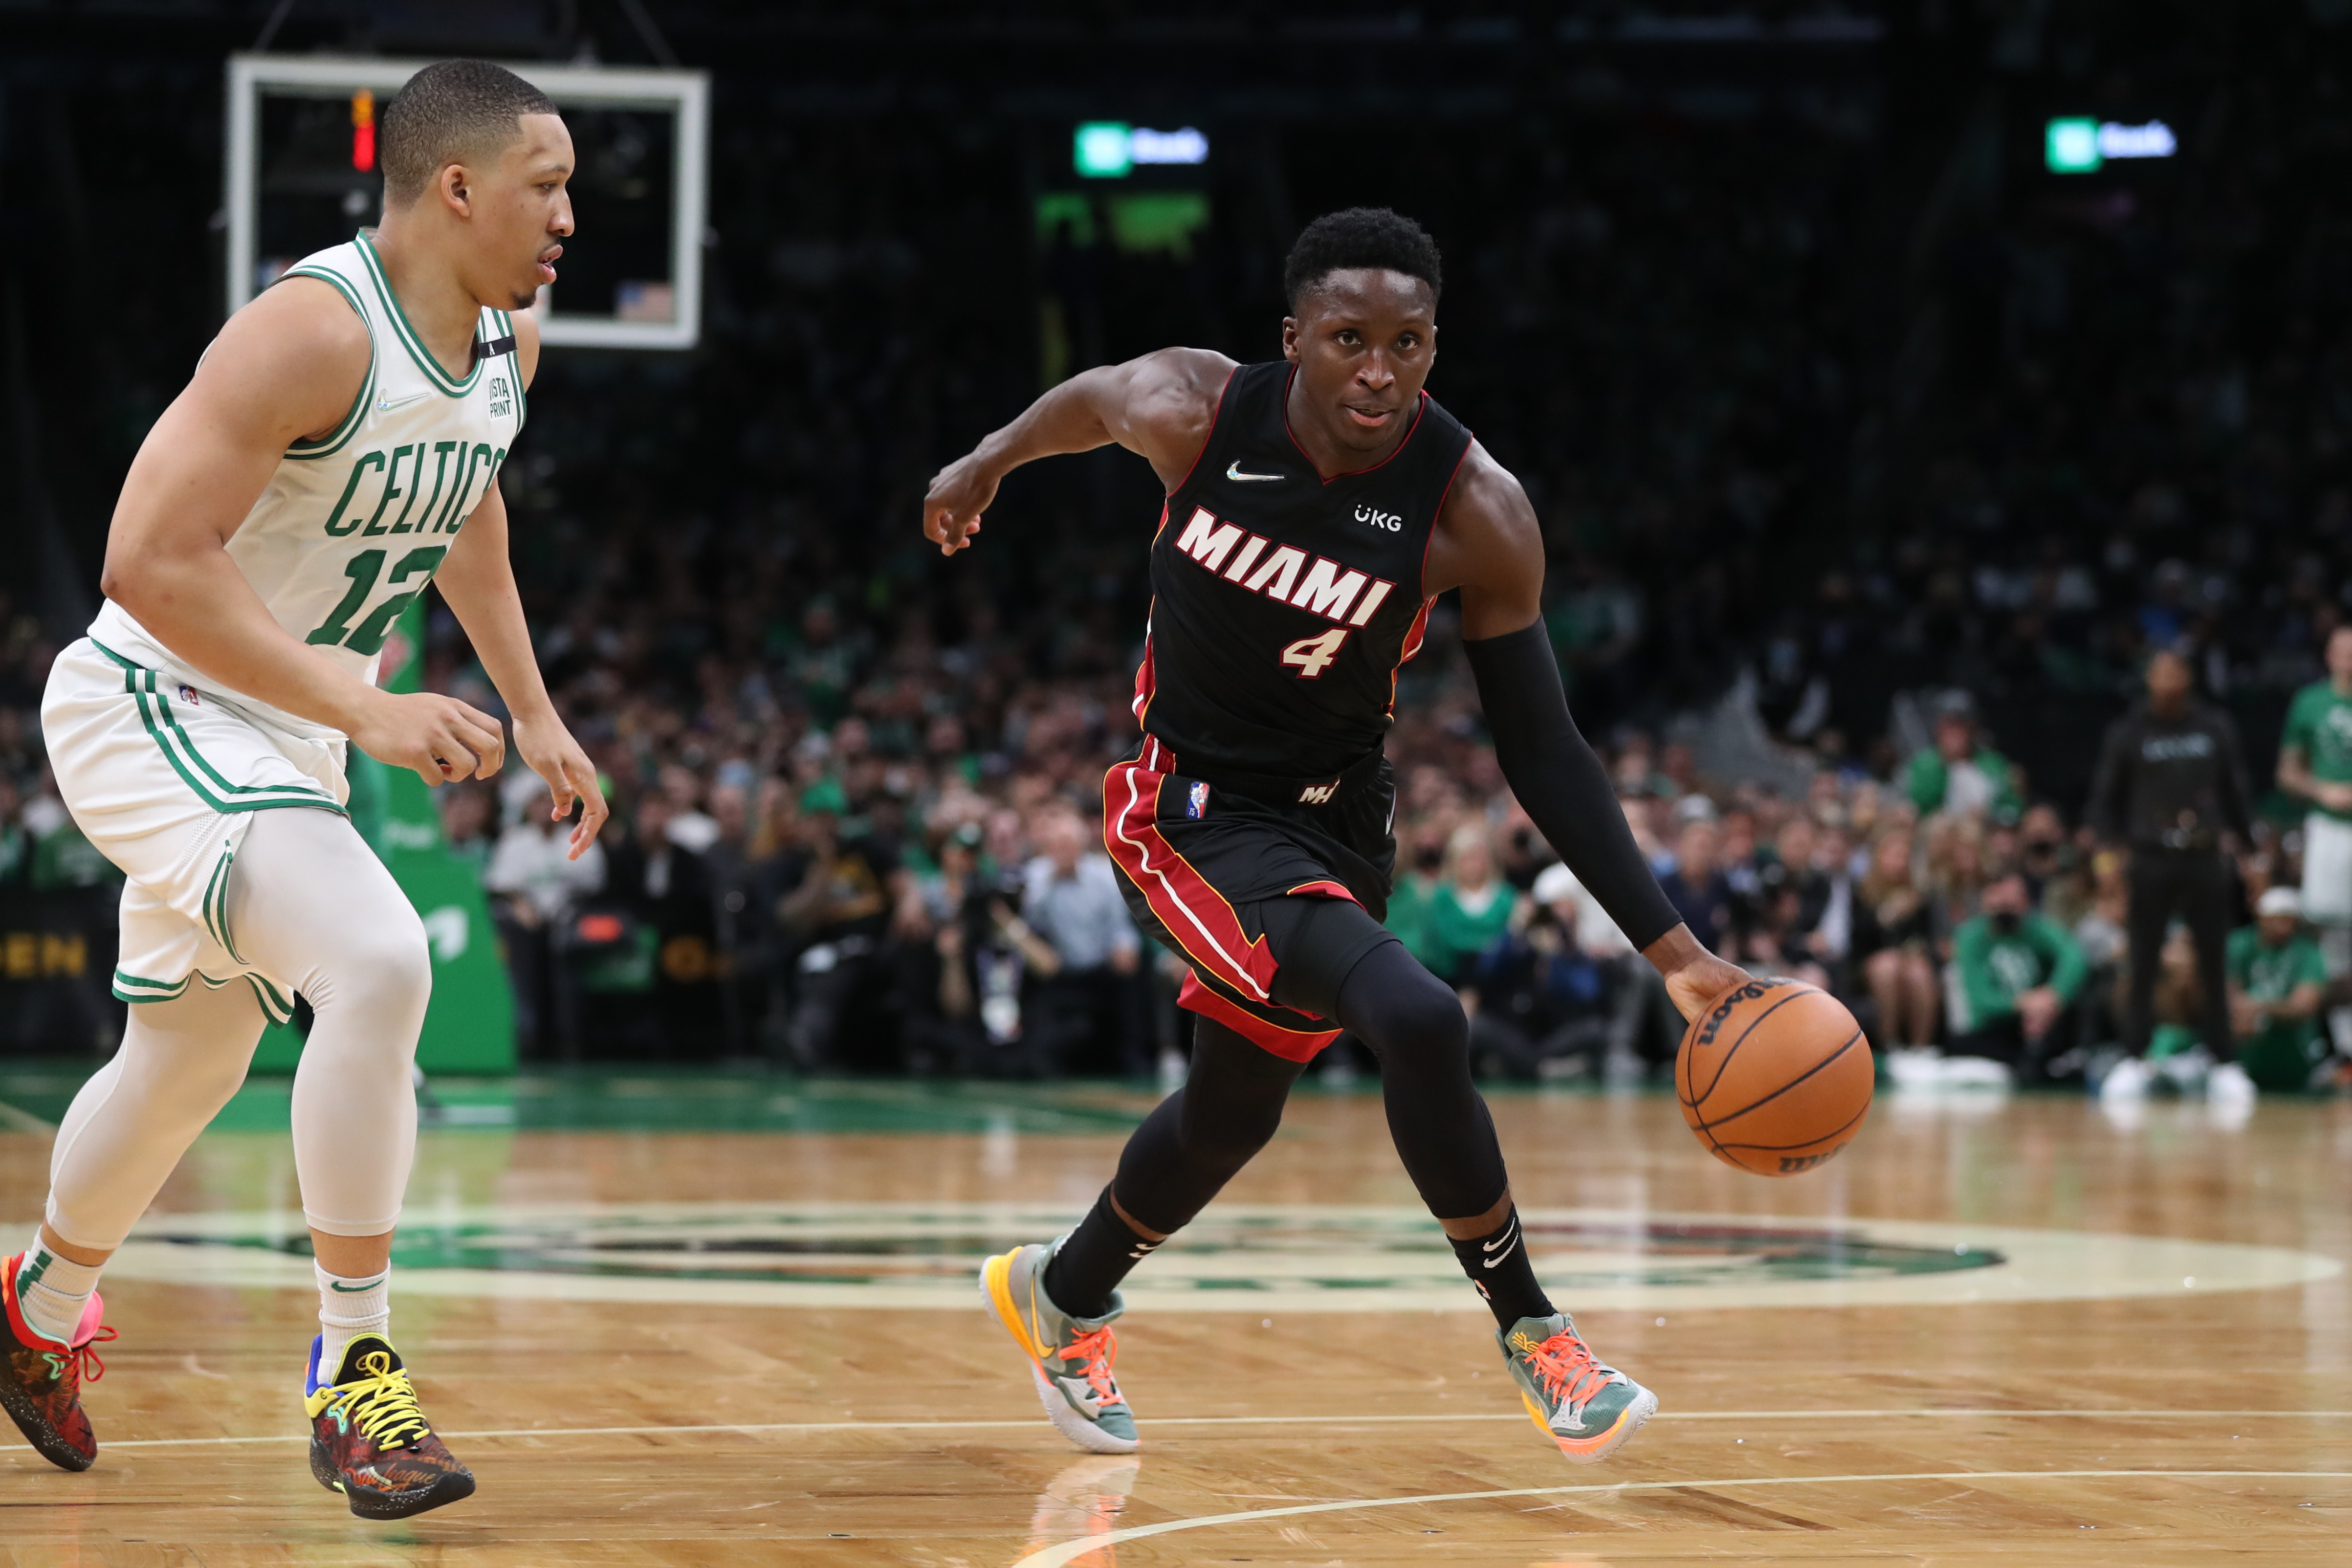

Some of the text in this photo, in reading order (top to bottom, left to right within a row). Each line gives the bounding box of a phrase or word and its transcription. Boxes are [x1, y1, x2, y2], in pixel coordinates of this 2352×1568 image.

[490, 400, 510, 419] PRINT
[1174, 505, 1397, 629] MIAMI
[304, 544, 447, 656] 12
[1279, 626, 1352, 680] 4
[1188, 807, 1196, 817] 75
